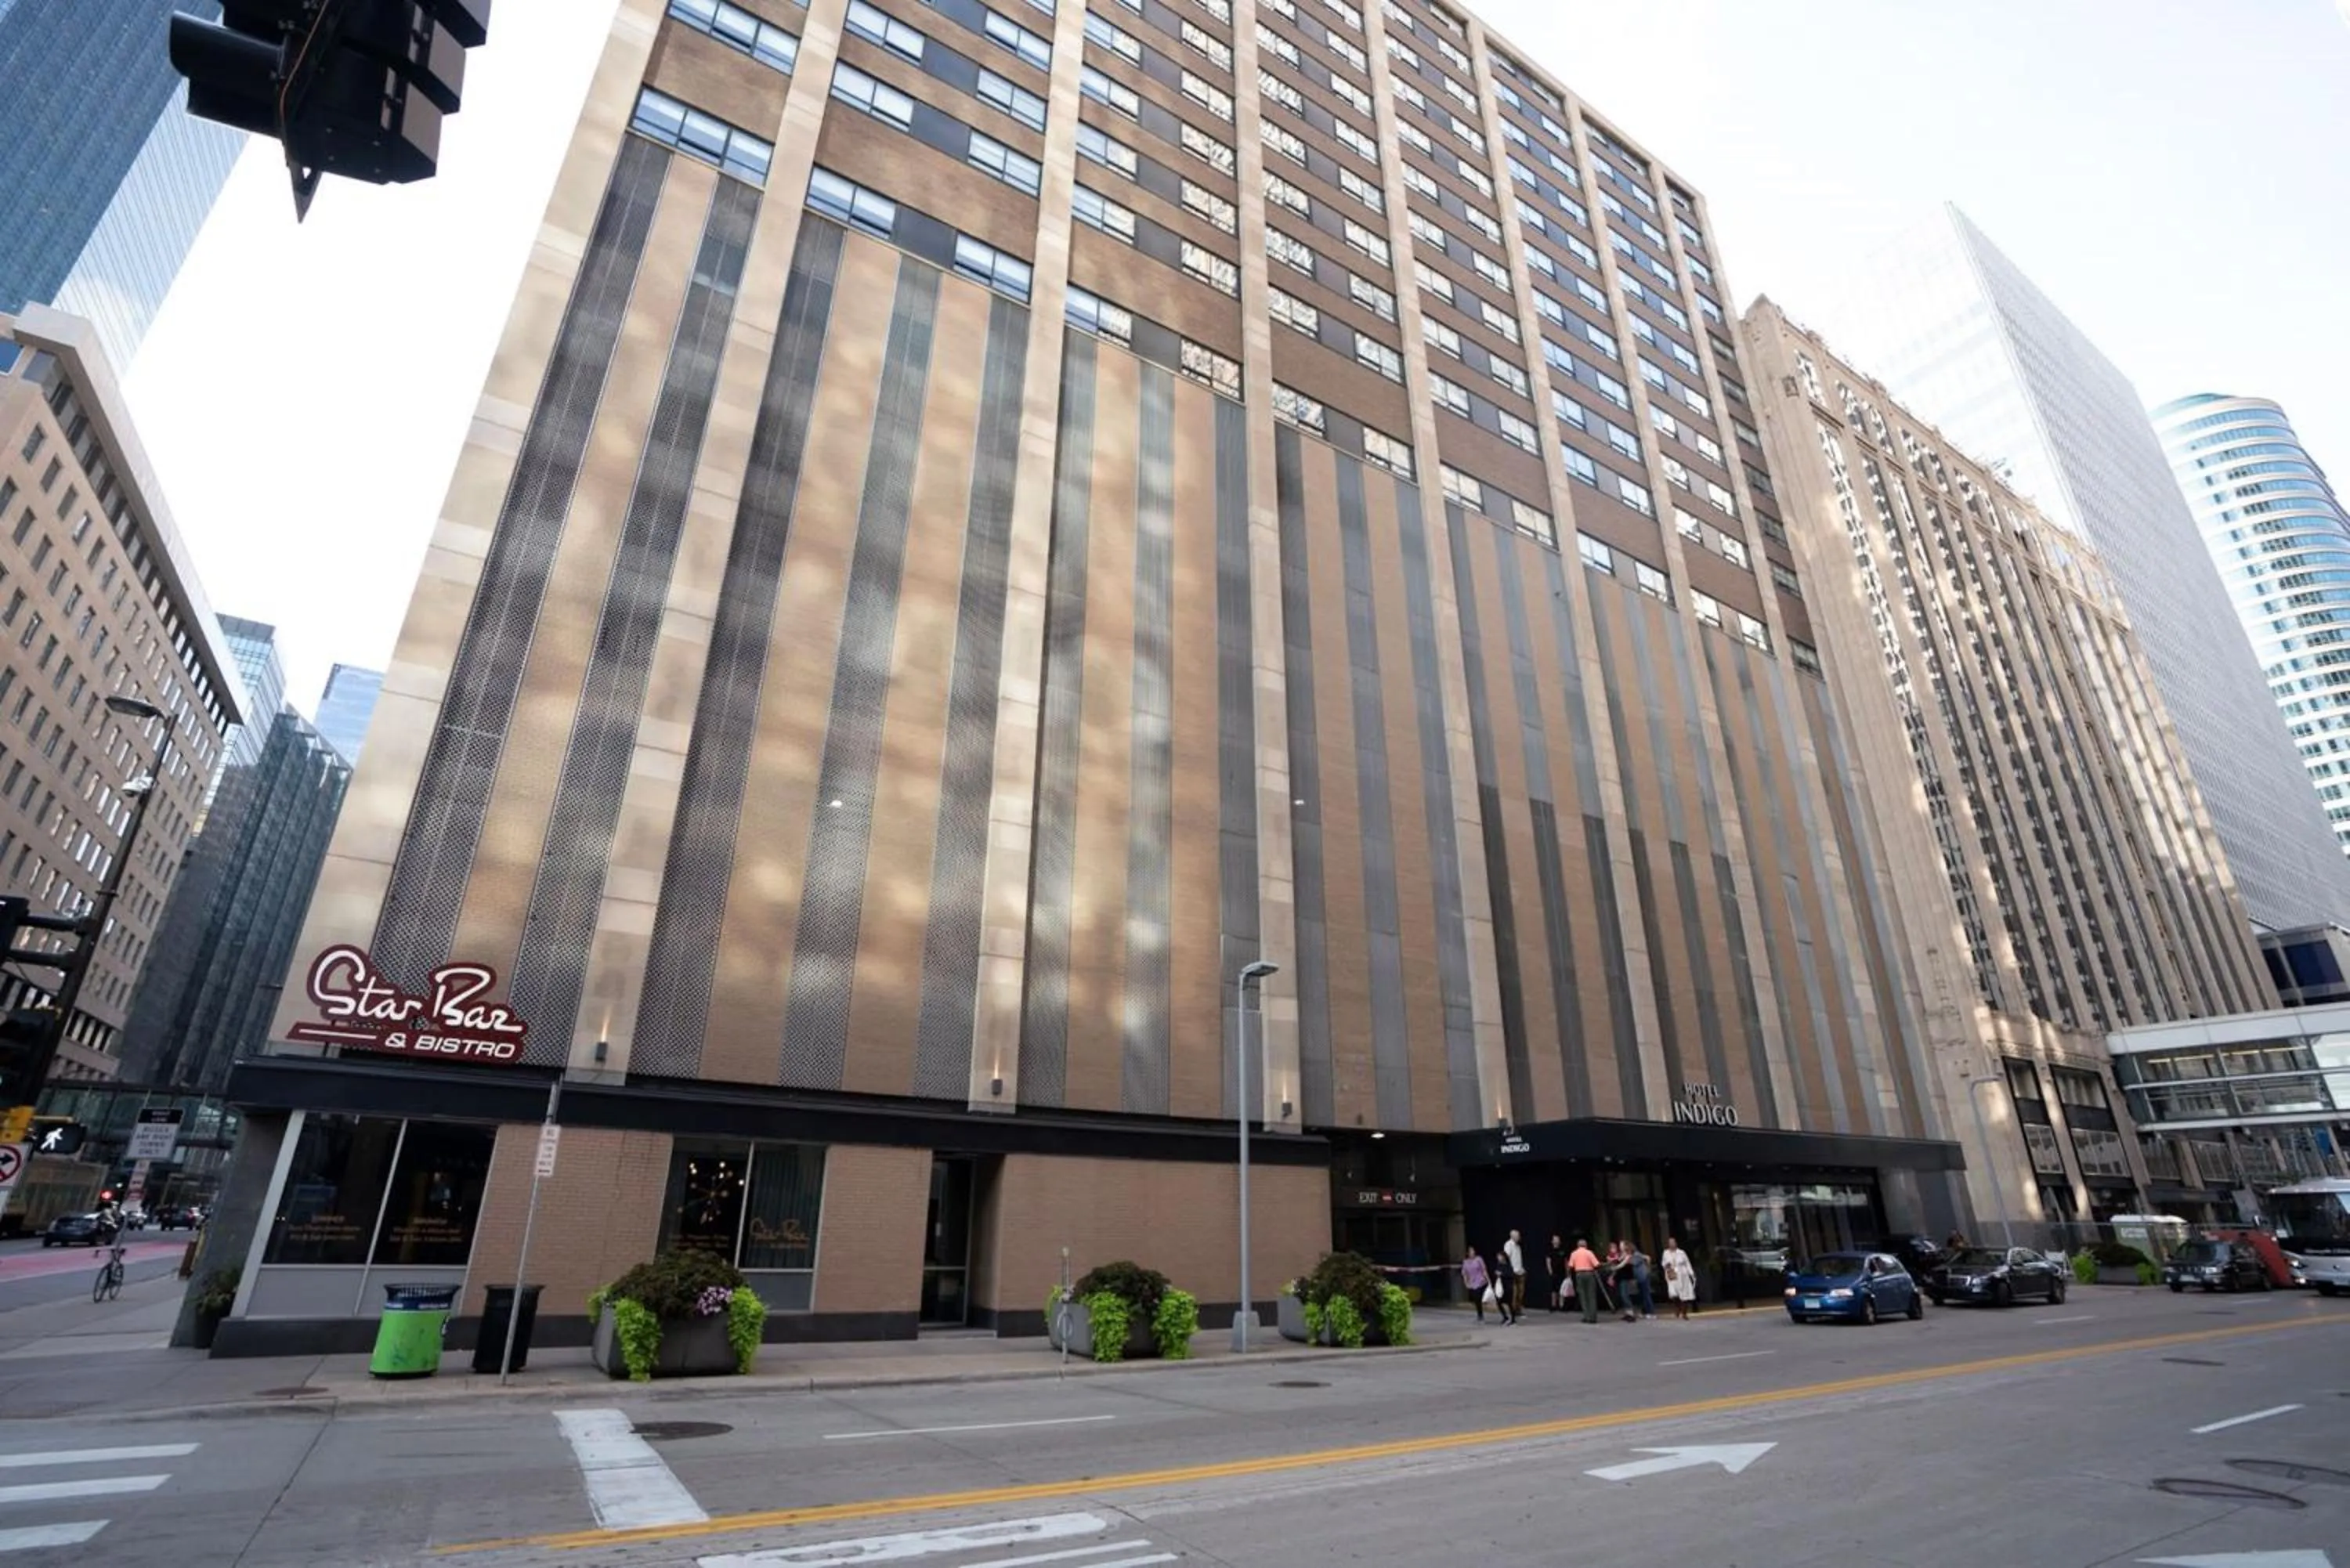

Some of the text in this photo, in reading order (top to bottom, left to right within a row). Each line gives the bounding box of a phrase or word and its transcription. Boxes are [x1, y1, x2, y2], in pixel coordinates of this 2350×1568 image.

[313, 949, 523, 1033] Star Bar
[385, 1033, 516, 1058] & BISTRO
[1684, 1082, 1720, 1098] HOTEL
[1674, 1100, 1738, 1126] INDIGO
[1501, 1143, 1530, 1154] INDIGO
[1358, 1191, 1417, 1205] EXIT ONLY
